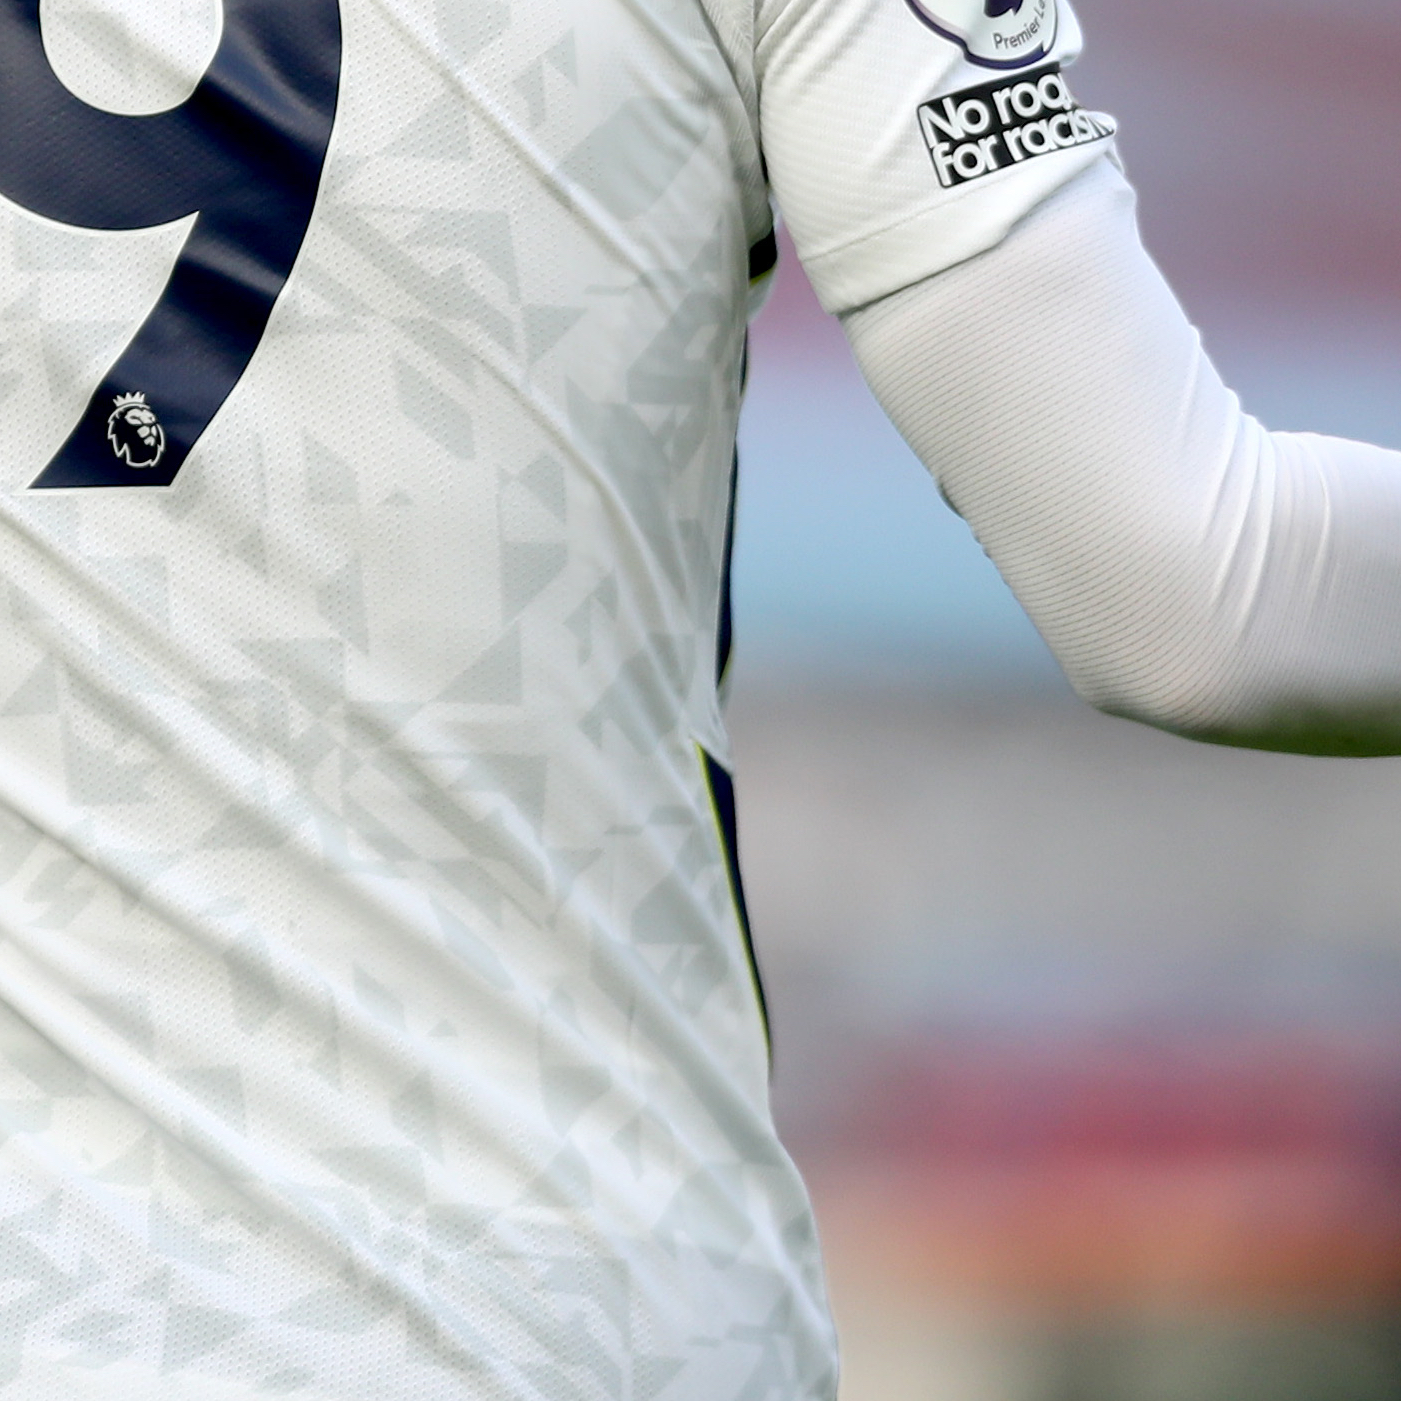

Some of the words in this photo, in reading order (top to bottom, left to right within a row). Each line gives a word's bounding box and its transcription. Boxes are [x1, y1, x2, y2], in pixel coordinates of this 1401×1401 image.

[993, 17, 1041, 49] Premier
[920, 95, 990, 145] No
[992, 72, 1073, 125] roo
[931, 135, 999, 186] for
